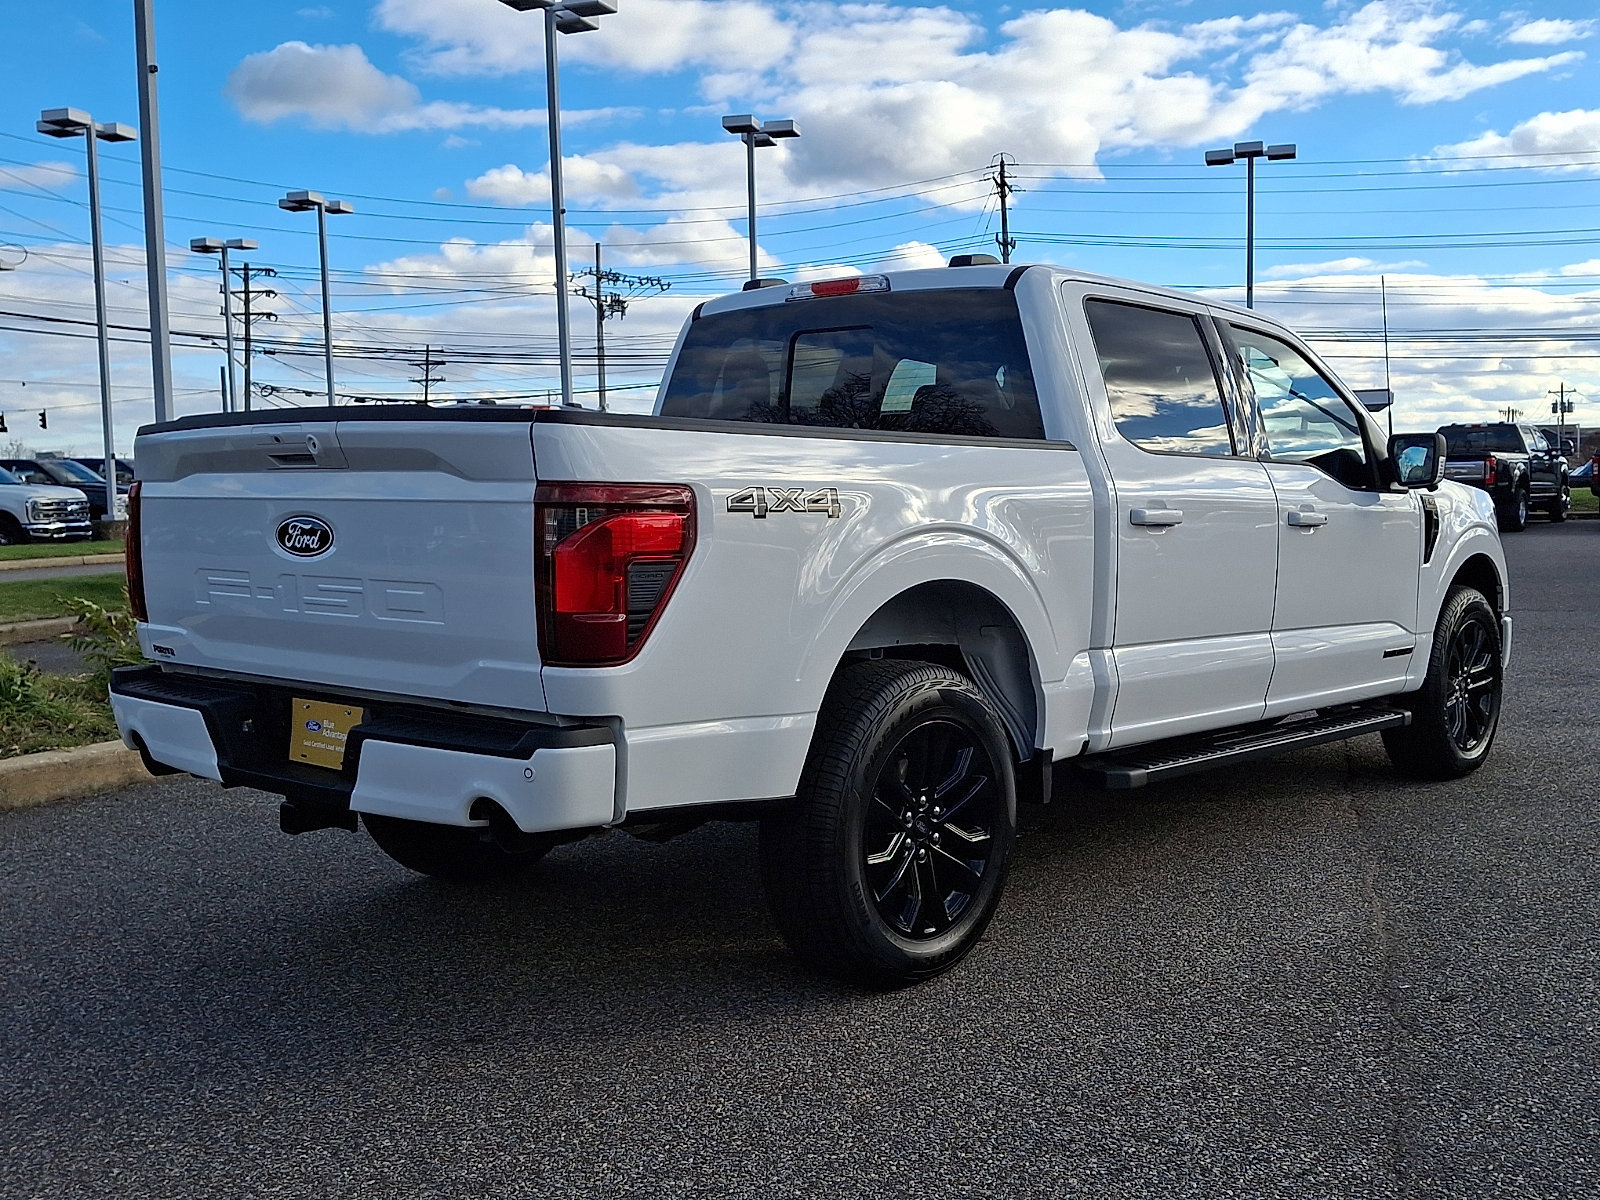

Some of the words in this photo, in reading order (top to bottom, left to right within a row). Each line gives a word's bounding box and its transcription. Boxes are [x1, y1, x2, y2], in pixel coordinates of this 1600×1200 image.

[285, 521, 321, 549] Ford
[195, 568, 445, 625] F-150
[323, 719, 335, 728] Blue
